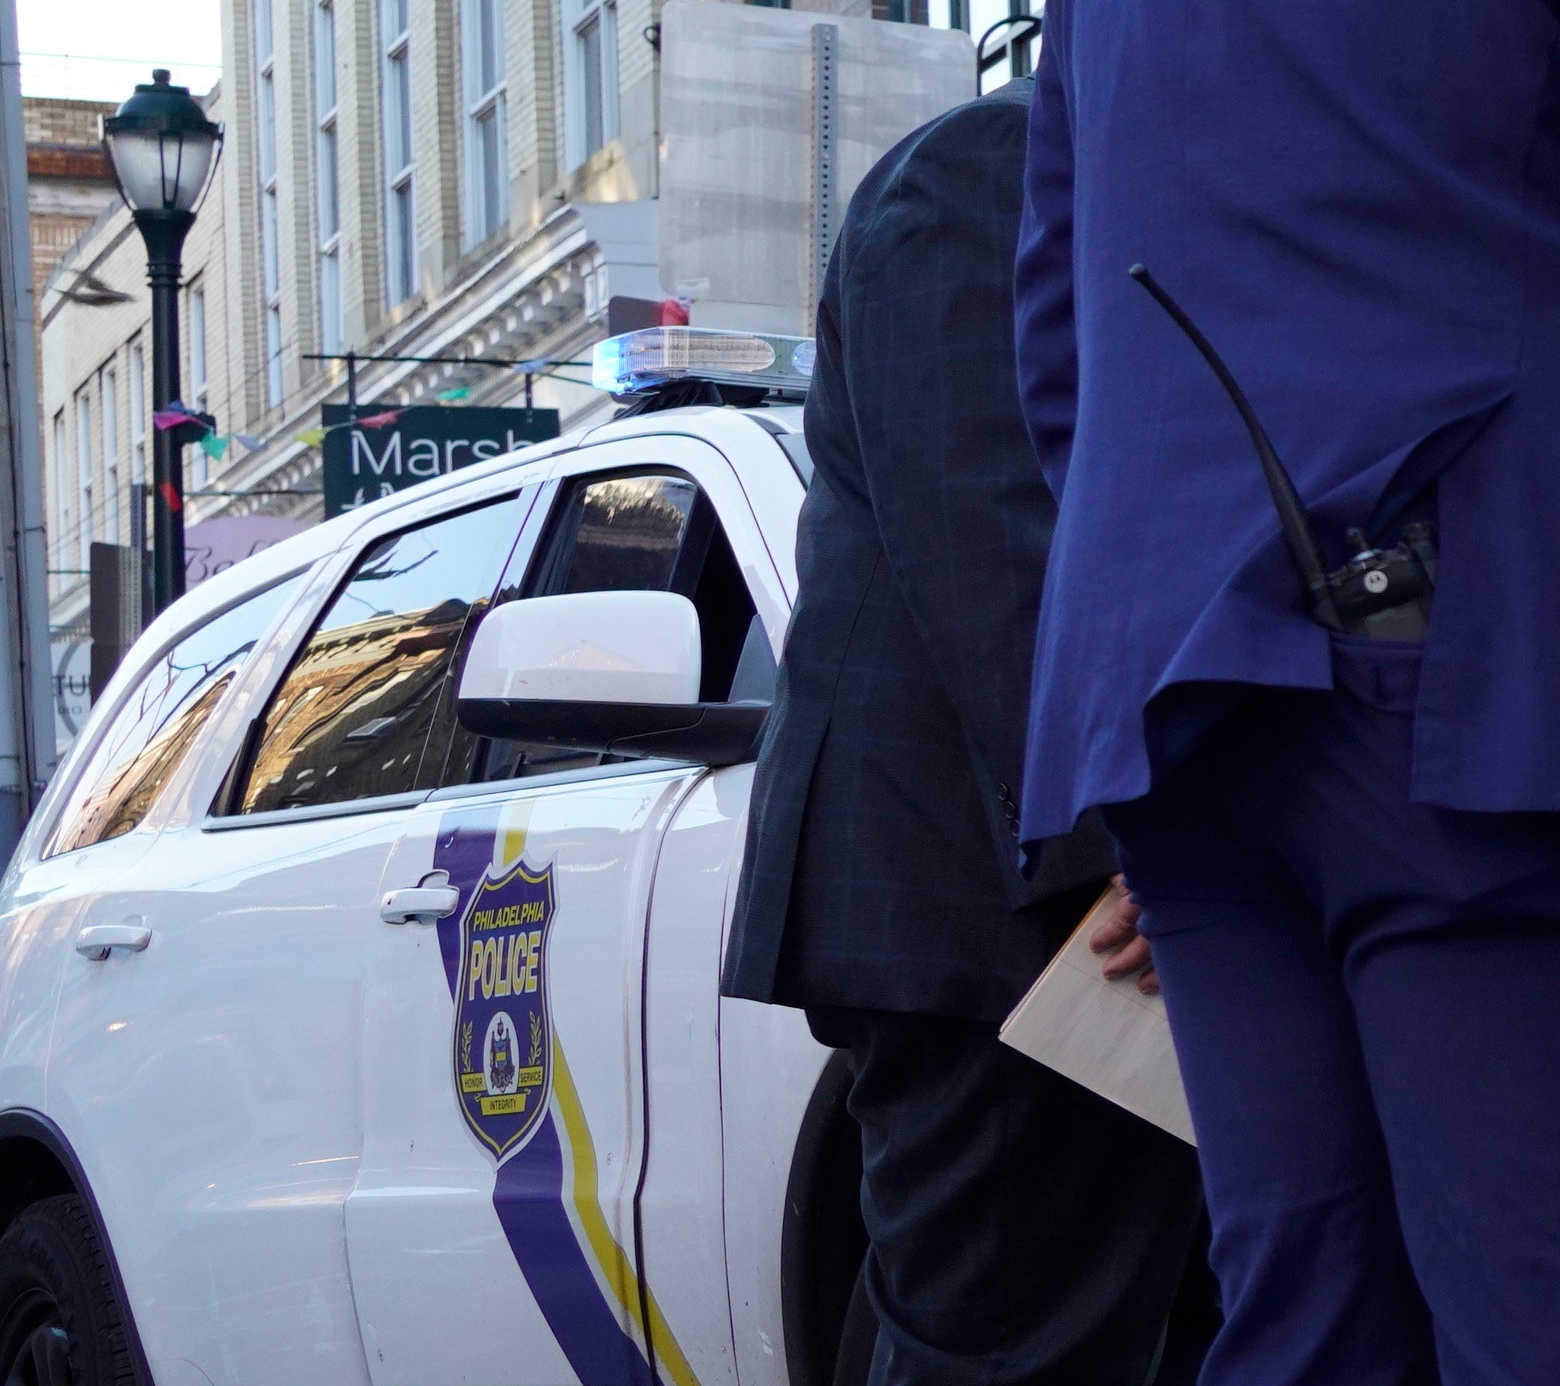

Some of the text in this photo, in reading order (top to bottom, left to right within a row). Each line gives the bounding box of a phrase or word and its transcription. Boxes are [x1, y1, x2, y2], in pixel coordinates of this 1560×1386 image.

[472, 900, 545, 932] PHILADELPHIA
[468, 930, 542, 1001] POLICE
[464, 1070, 542, 1089] HONOR SERVICE
[489, 1098, 517, 1111] INTEGRITY
